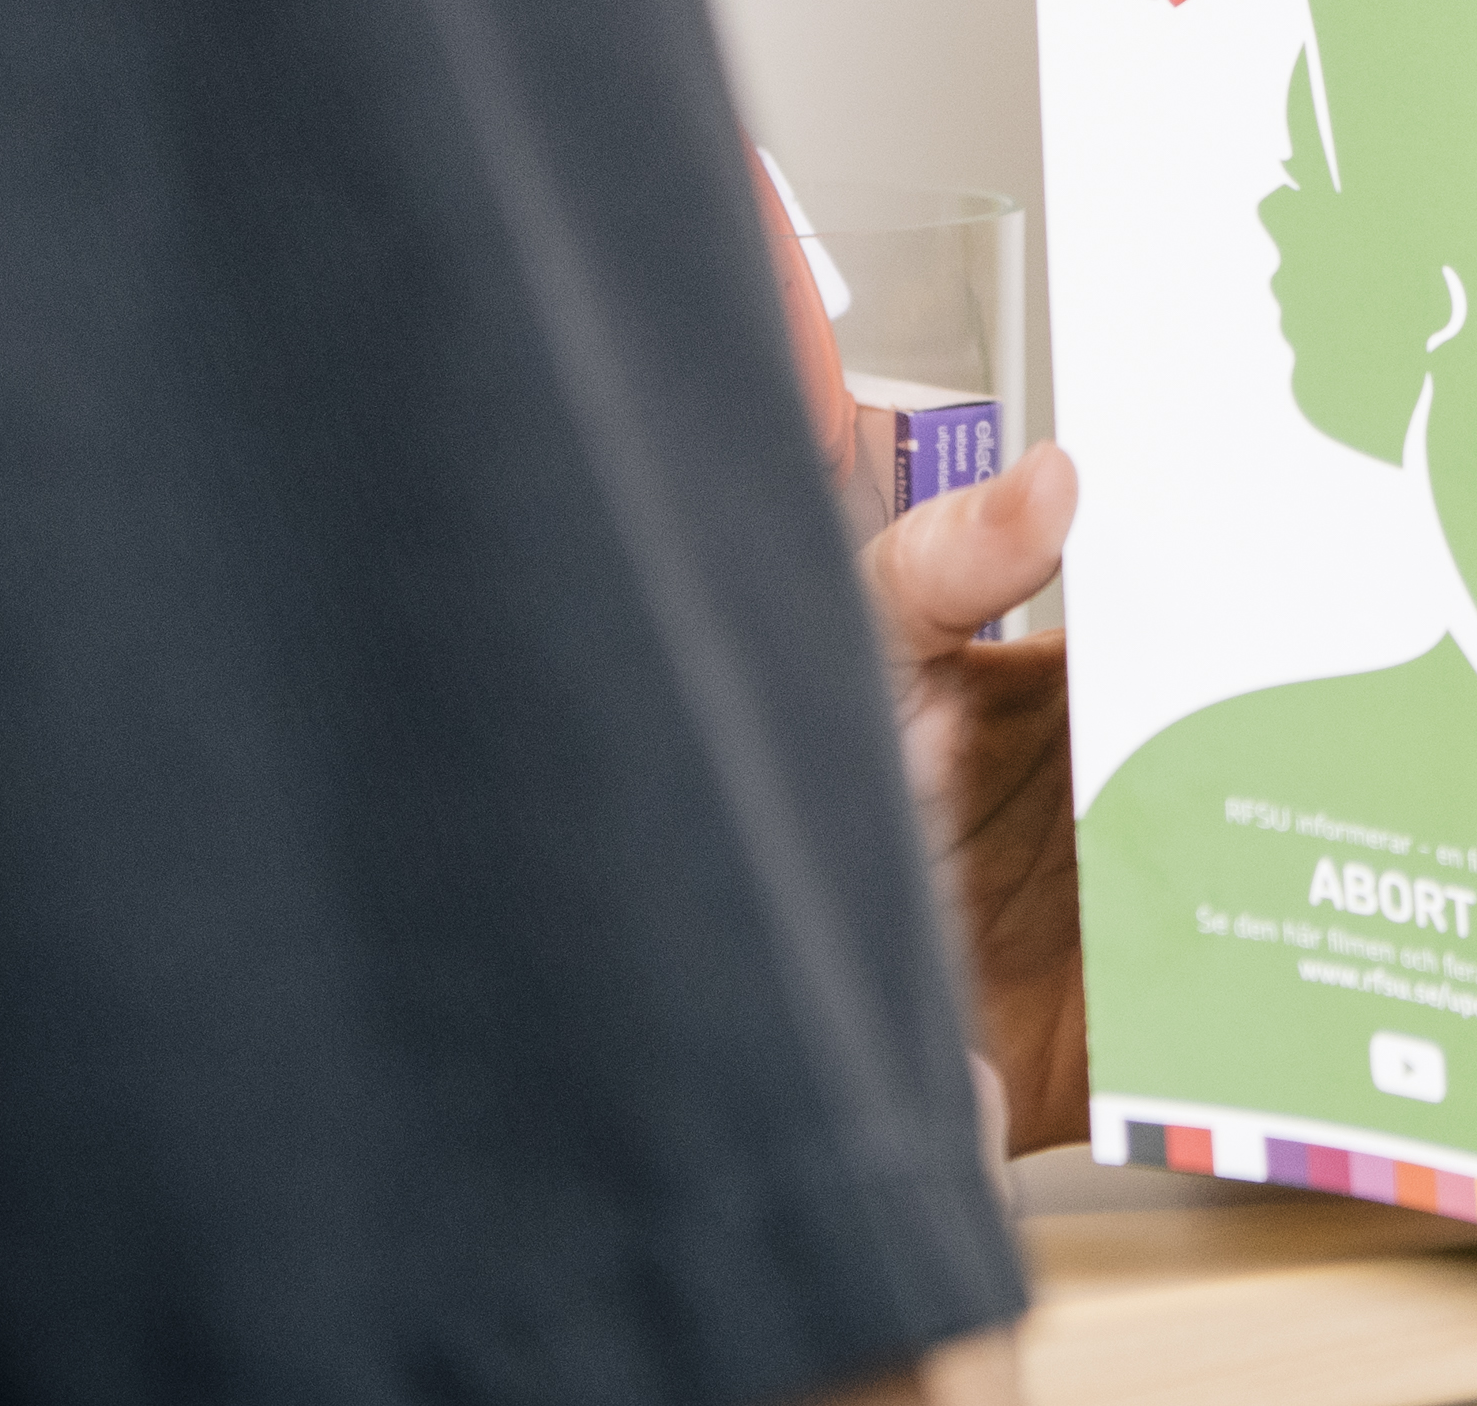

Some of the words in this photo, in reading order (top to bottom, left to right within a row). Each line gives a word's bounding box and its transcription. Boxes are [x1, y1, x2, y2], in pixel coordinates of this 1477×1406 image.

[974, 420, 994, 484] ellaO
[1225, 797, 1291, 832] RFSU
[1295, 811, 1412, 856] informerar
[1435, 844, 1464, 870] en
[1195, 905, 1230, 936] Se
[1233, 912, 1279, 943] den
[1282, 917, 1322, 950] här
[1327, 926, 1397, 964] filmen
[1399, 947, 1439, 975] och
